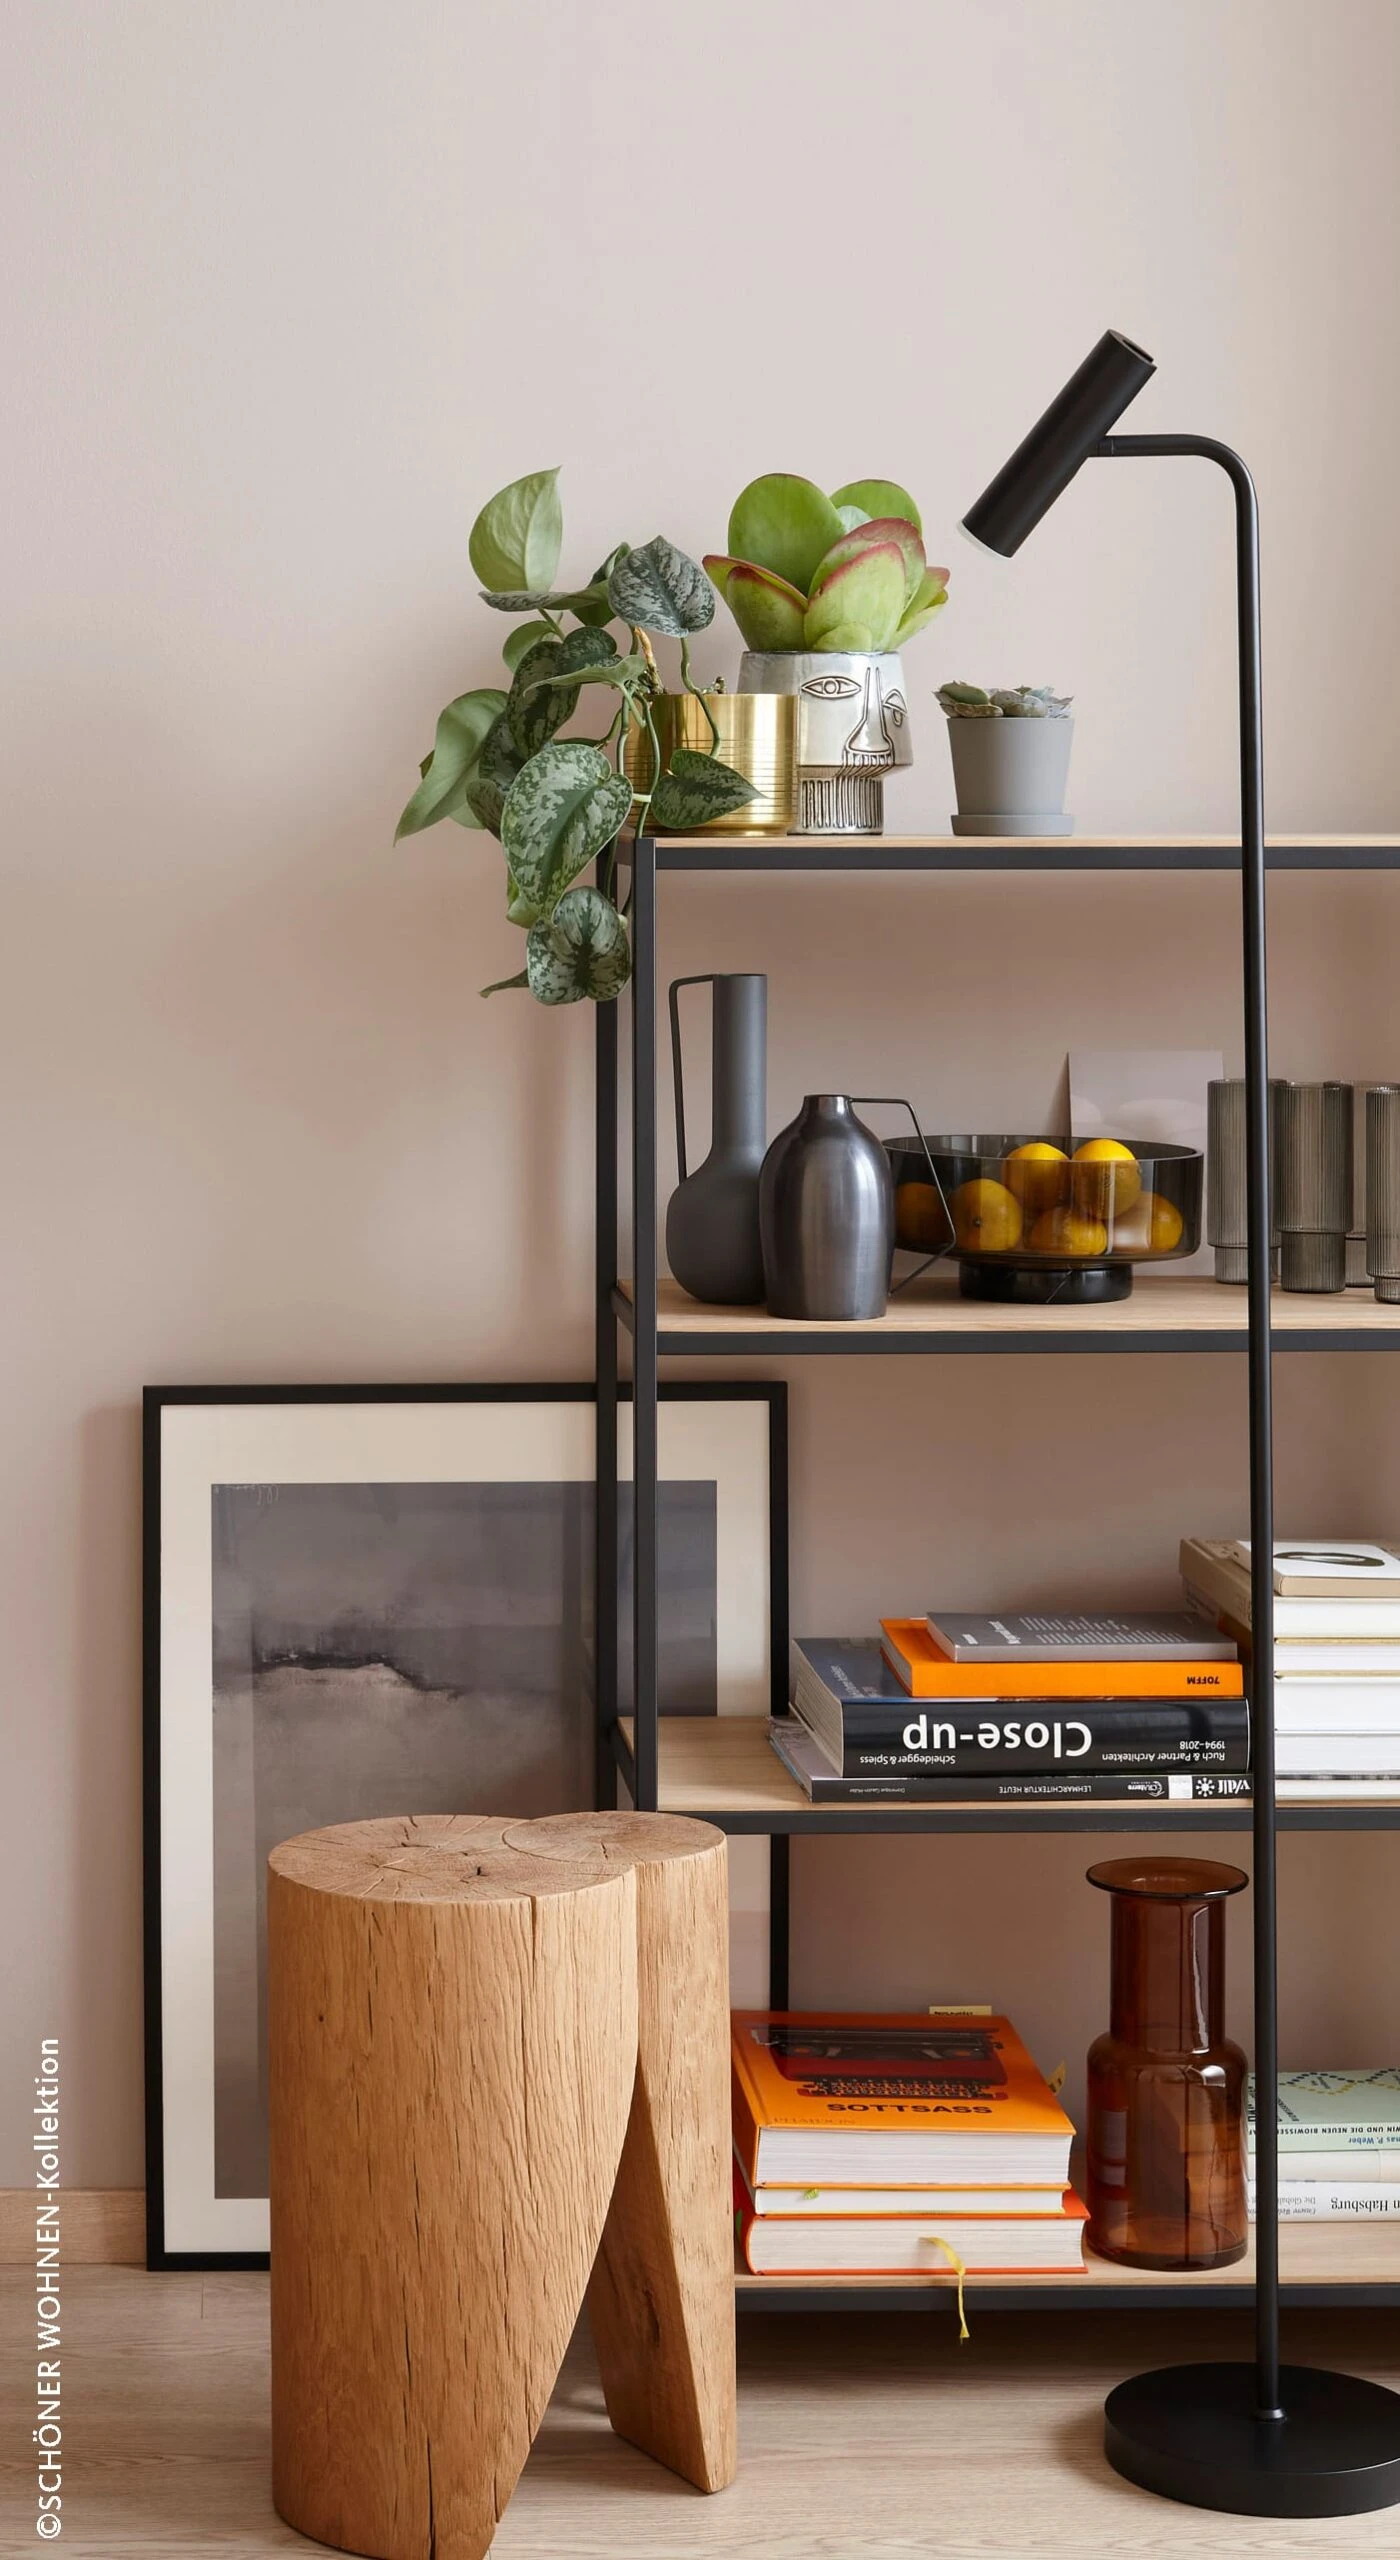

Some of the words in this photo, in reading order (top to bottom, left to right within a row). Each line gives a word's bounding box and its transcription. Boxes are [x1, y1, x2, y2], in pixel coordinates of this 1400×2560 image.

[1187, 1676, 1220, 1685] 70FFM
[902, 1714, 1092, 1758] Close-up
[859, 1754, 889, 1765] Spiess
[897, 1753, 956, 1765] Scheidegger
[1102, 1753, 1156, 1763] Architekten
[1157, 1752, 1191, 1762] Partner
[1193, 1752, 1201, 1761] &
[1202, 1752, 1225, 1762] Ruch
[998, 1785, 1023, 1794] HEUTE
[1023, 1784, 1092, 1794] LEHMARCHITEKTUR
[827, 2103, 993, 2114] SOTTSASS
[1348, 2137, 1374, 2146] Weber
[1330, 2197, 1388, 2213] Habsburg
